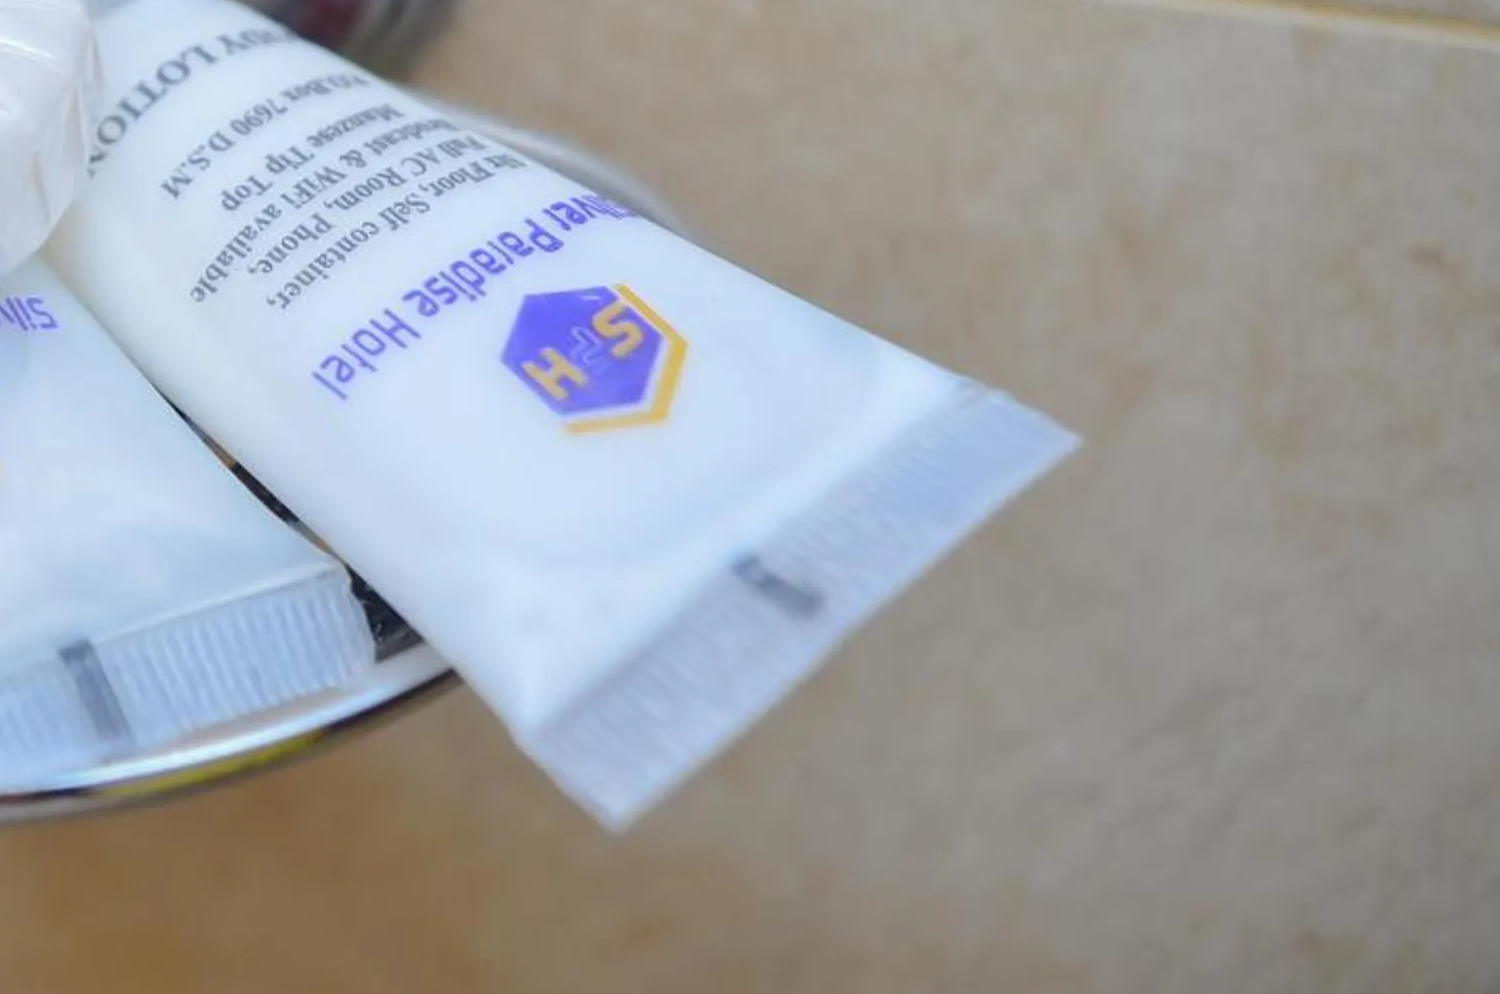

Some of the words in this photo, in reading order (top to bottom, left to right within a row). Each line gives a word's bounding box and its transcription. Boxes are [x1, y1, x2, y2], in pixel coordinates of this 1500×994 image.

[266, 144, 316, 175] Tip
[339, 149, 369, 170] &
[400, 148, 441, 177] AC
[418, 160, 496, 196] Floor,
[221, 175, 274, 214] Top
[280, 166, 347, 210] WiFi
[324, 166, 408, 212] Room,
[378, 192, 432, 232] Self
[189, 204, 283, 304] available
[248, 212, 334, 276] Phone,
[266, 220, 380, 309] container,
[402, 218, 564, 316] Paradise
[311, 309, 421, 401] Hotel
